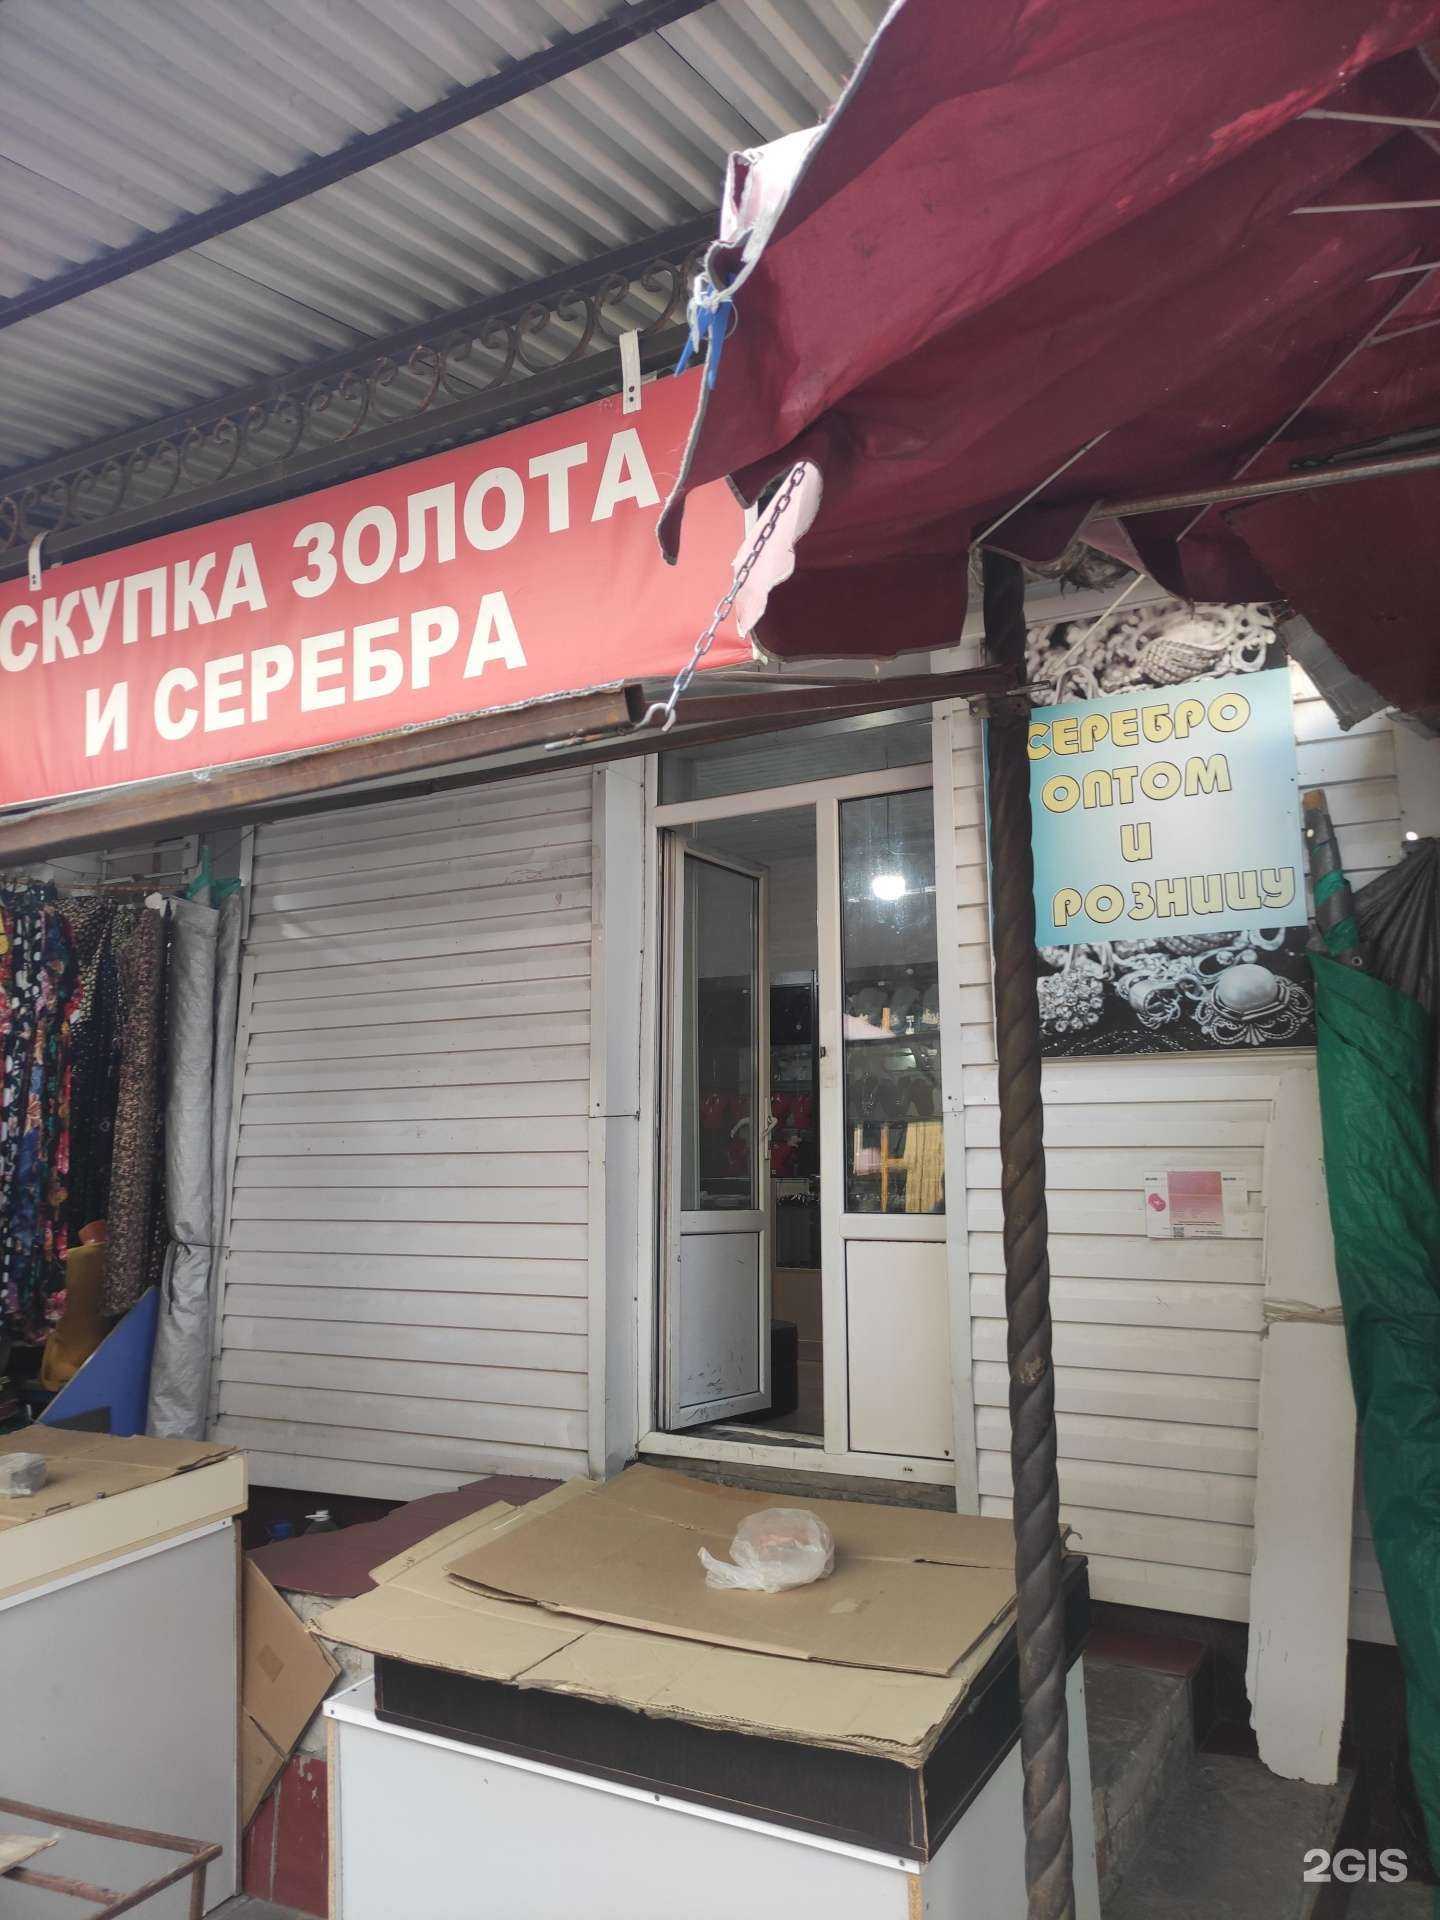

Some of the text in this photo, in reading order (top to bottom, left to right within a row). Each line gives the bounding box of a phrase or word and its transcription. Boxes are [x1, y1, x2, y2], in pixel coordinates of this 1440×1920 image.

[0, 428, 661, 672] СКУПКА ЗОЛОТА
[85, 590, 527, 758] И СЕРЕБРА
[1027, 692, 1251, 760] СЕРЕБРО
[1041, 753, 1232, 813] ОПТОМ
[1052, 866, 1296, 927] РОЗНИЦУ
